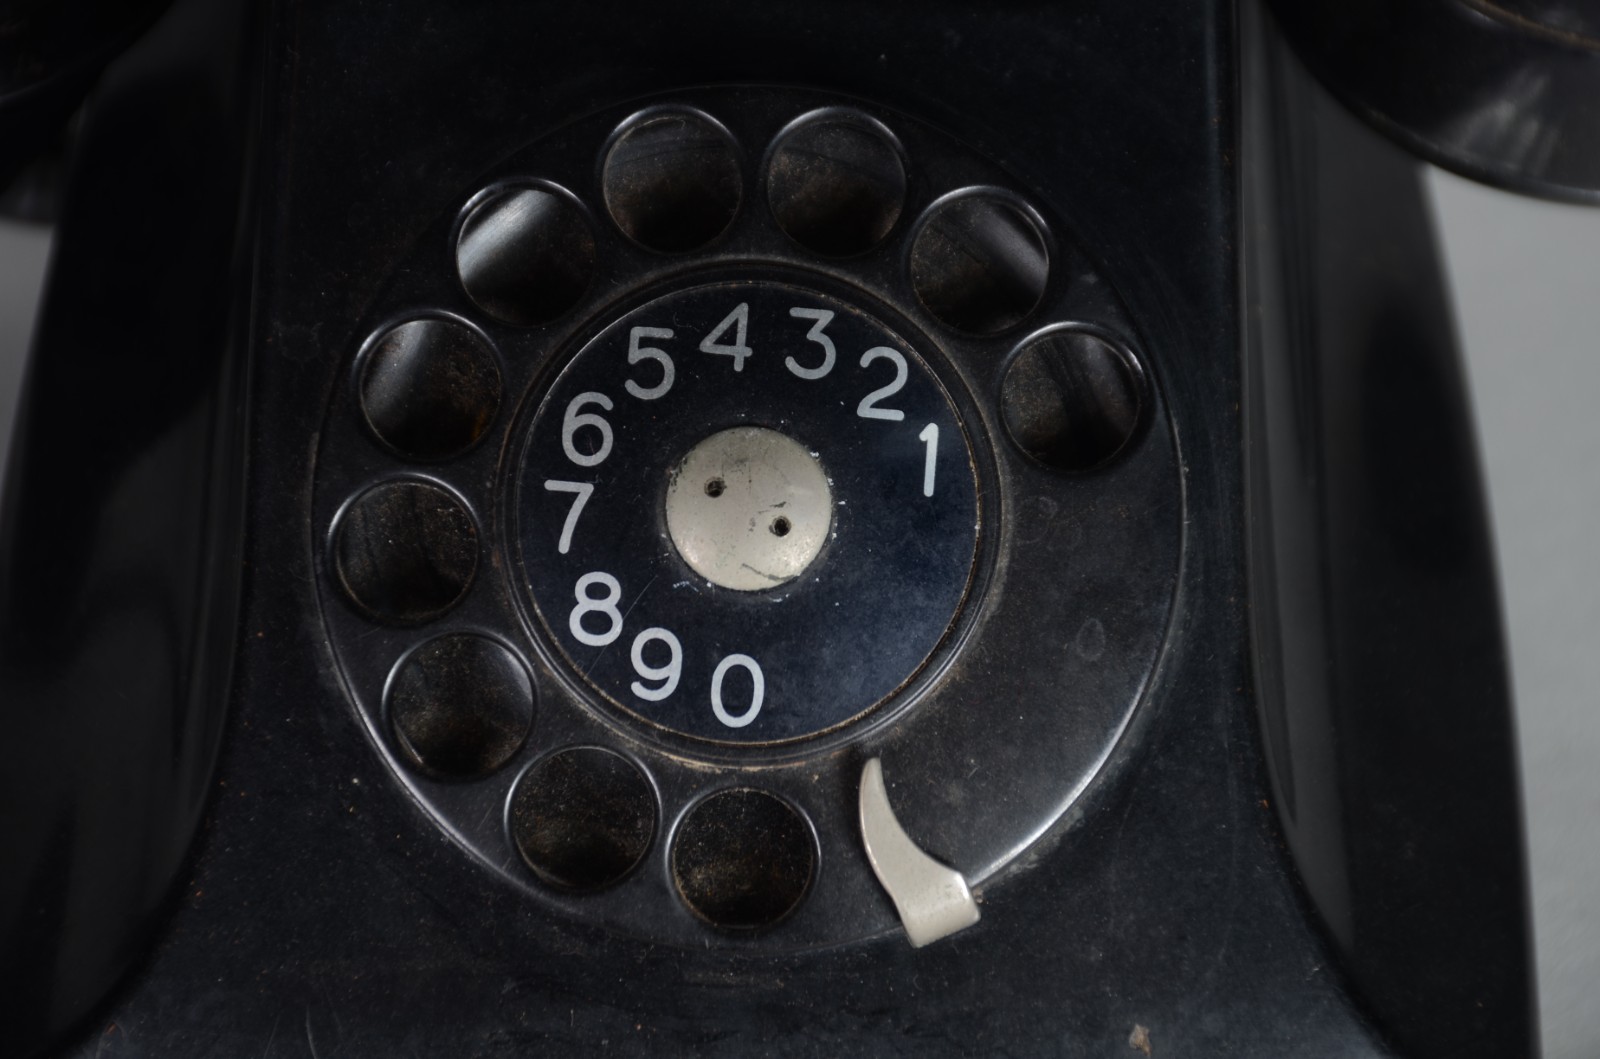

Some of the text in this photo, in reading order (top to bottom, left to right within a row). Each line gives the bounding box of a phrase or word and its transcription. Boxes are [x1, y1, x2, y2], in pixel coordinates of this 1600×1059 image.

[624, 326, 676, 401] 5
[700, 302, 753, 373] 4
[785, 307, 836, 381] 3
[857, 346, 909, 422] 2
[562, 391, 614, 468] 6
[918, 422, 940, 498] 1
[544, 479, 595, 555] 7
[568, 571, 624, 648] 8
[630, 627, 683, 702] 9
[710, 653, 765, 729] 0
